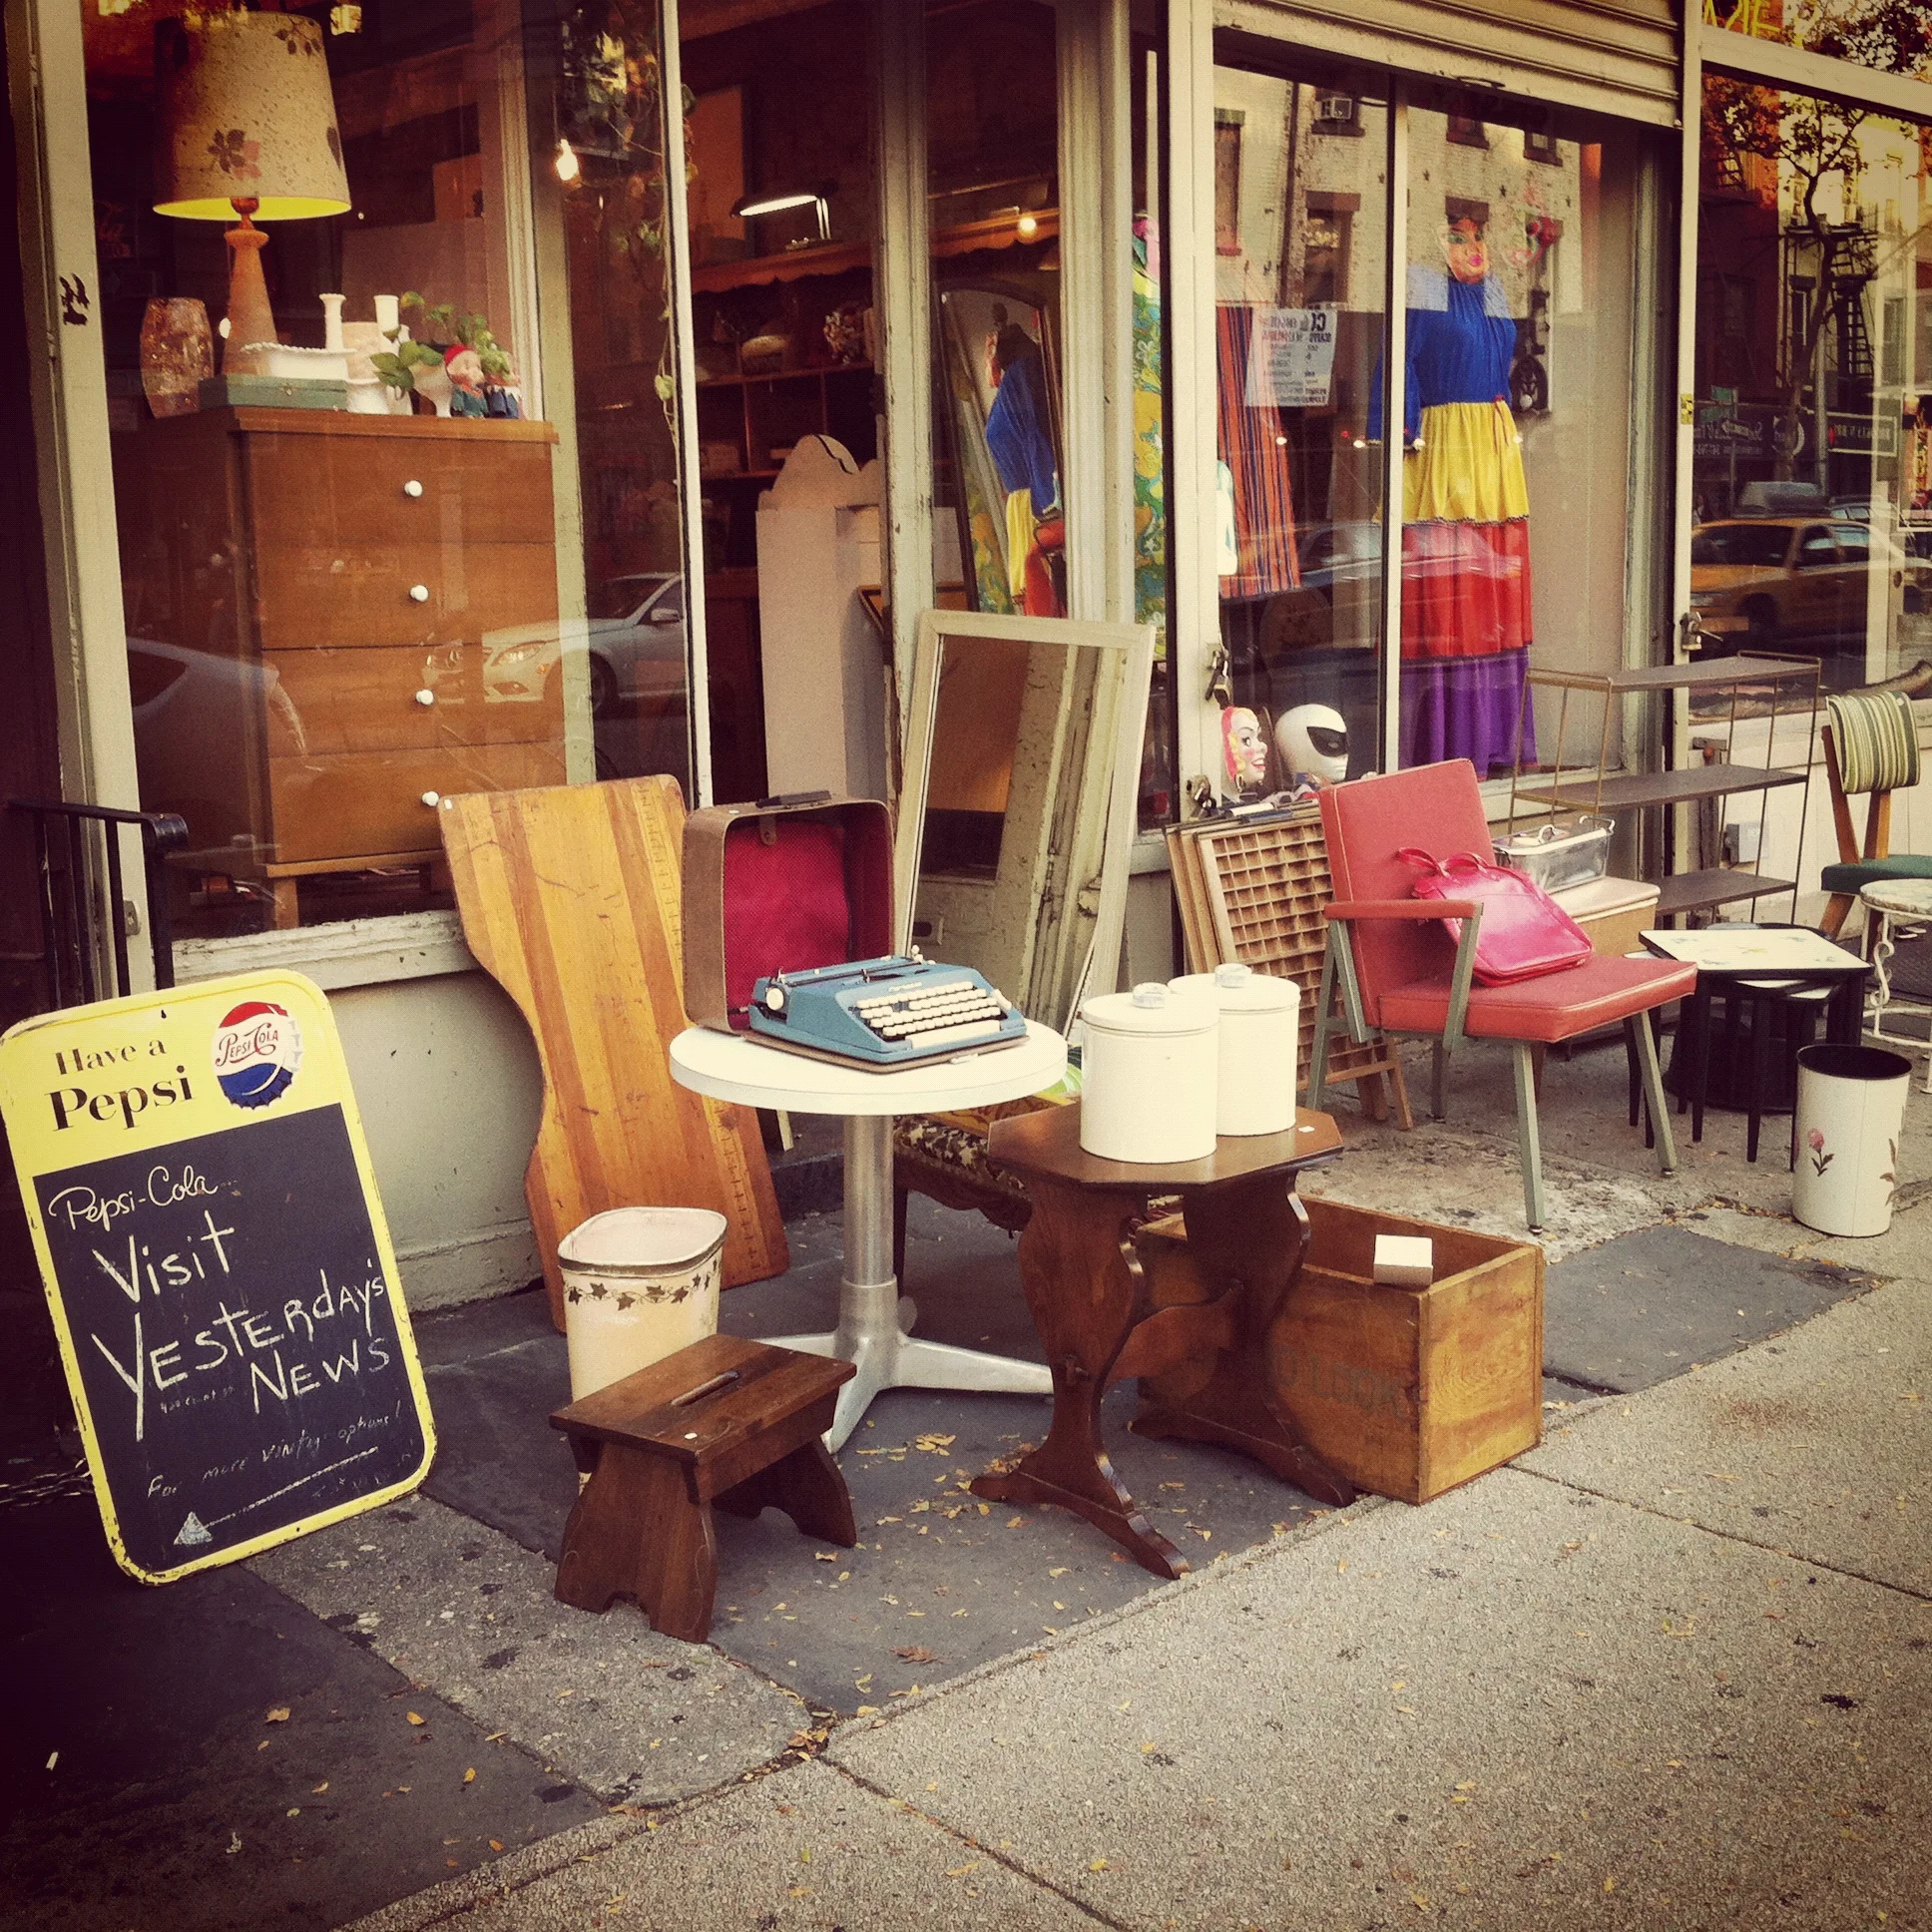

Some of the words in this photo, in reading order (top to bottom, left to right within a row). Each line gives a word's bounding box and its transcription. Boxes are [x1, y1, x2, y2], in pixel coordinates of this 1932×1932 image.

[53, 1045, 137, 1075] Have
[149, 1039, 167, 1057] a
[44, 1065, 198, 1132] Pepsi
[48, 1165, 219, 1231] Pepsi-Cola
[250, 1338, 390, 1414] NEWS
